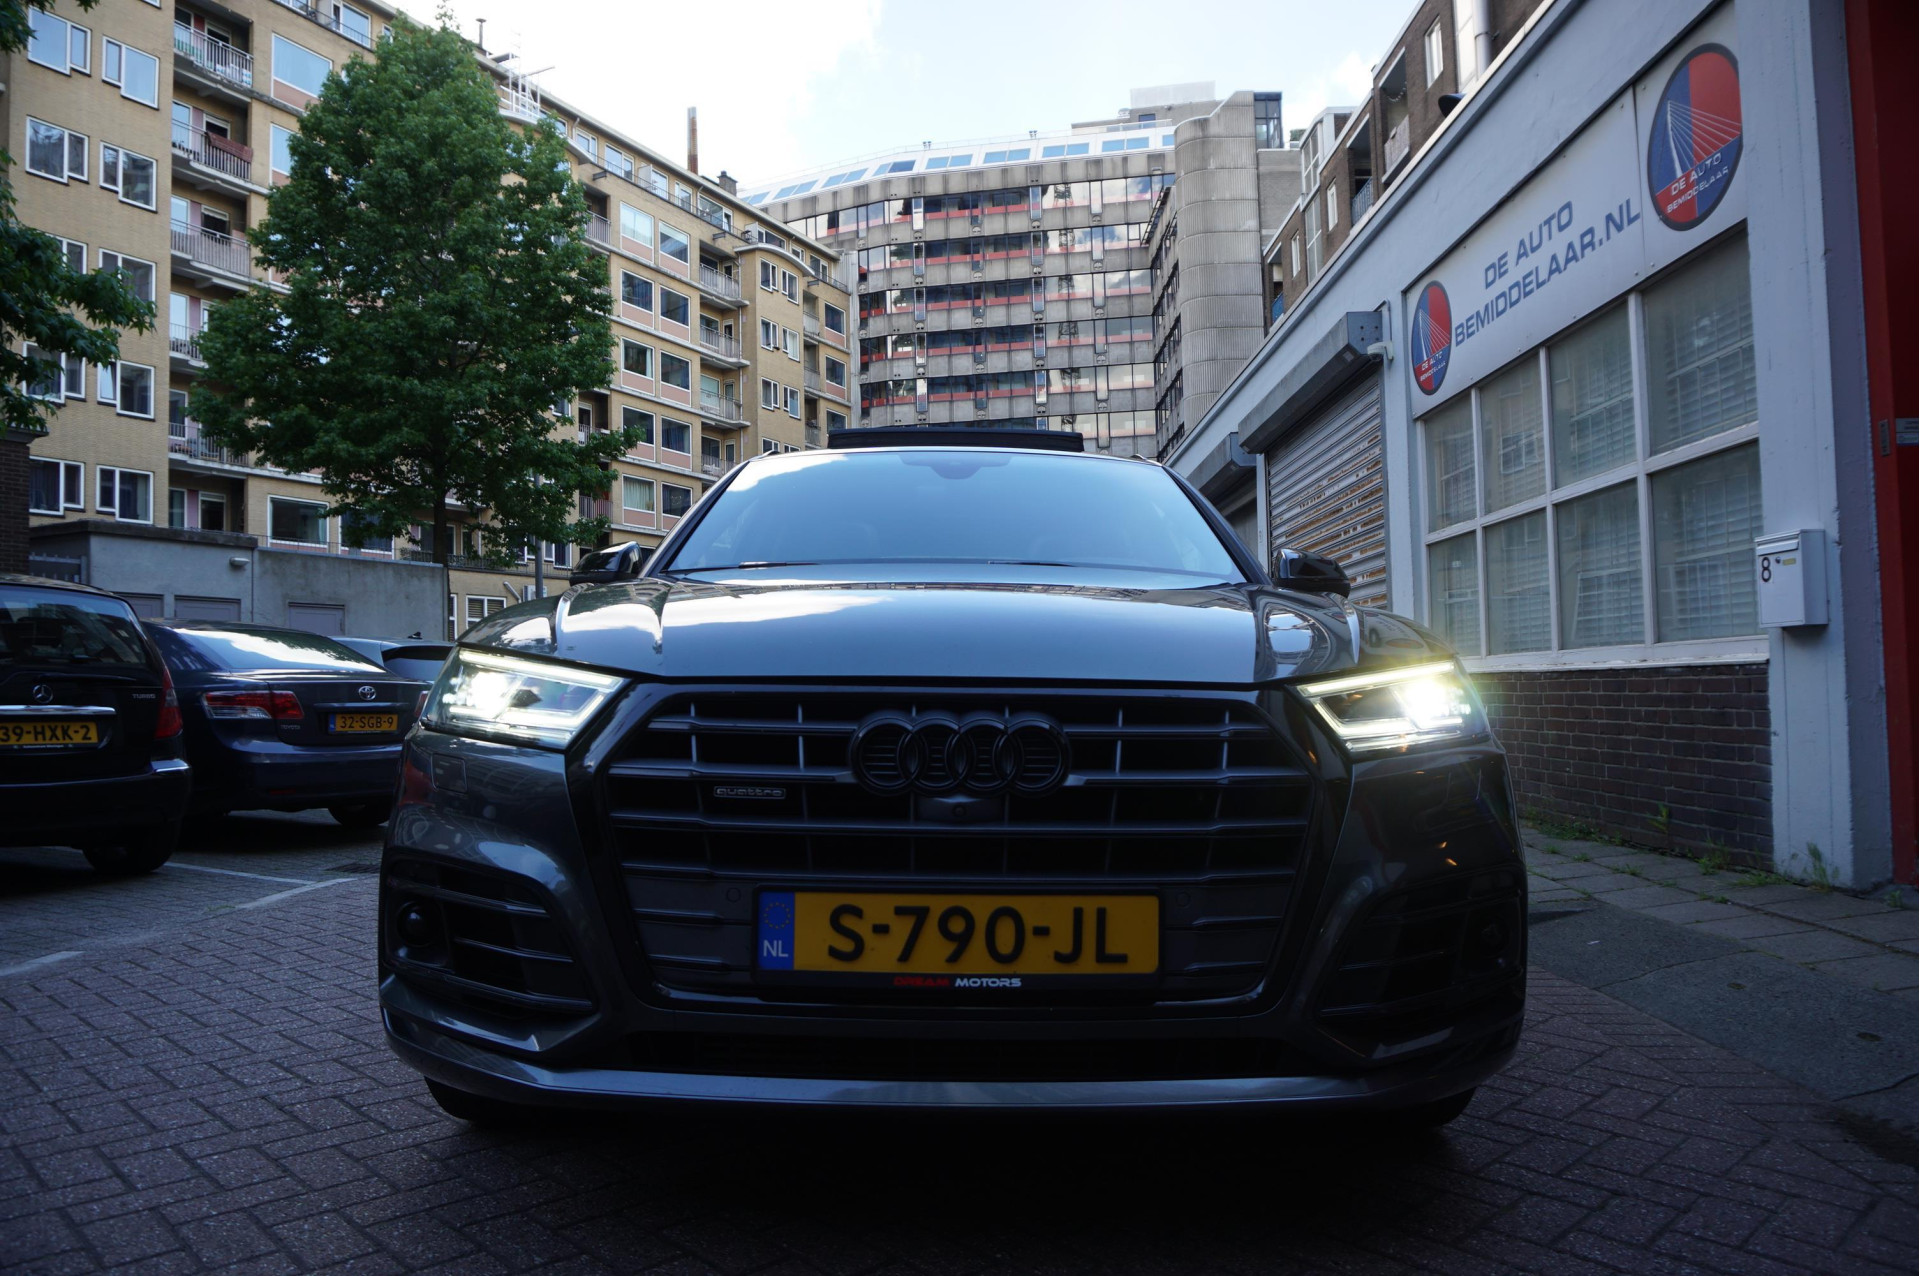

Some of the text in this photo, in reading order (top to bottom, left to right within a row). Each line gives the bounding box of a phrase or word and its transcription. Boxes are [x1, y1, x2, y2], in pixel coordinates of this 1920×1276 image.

[1671, 152, 1722, 196] DE AUTO
[1667, 166, 1729, 213] BEMIDDELAAR
[1484, 200, 1573, 290] DE AUTO
[1455, 198, 1641, 347] BEMIDDELAAR.NL
[1761, 556, 1772, 582] 8
[0, 725, 92, 742] 39-HXK-2
[340, 717, 394, 729] 32-SGB-9
[716, 788, 782, 797] quattro
[827, 904, 1129, 964] S-790-JL
[763, 940, 789, 957] NL
[893, 977, 1022, 988] DREAM MOTORS
